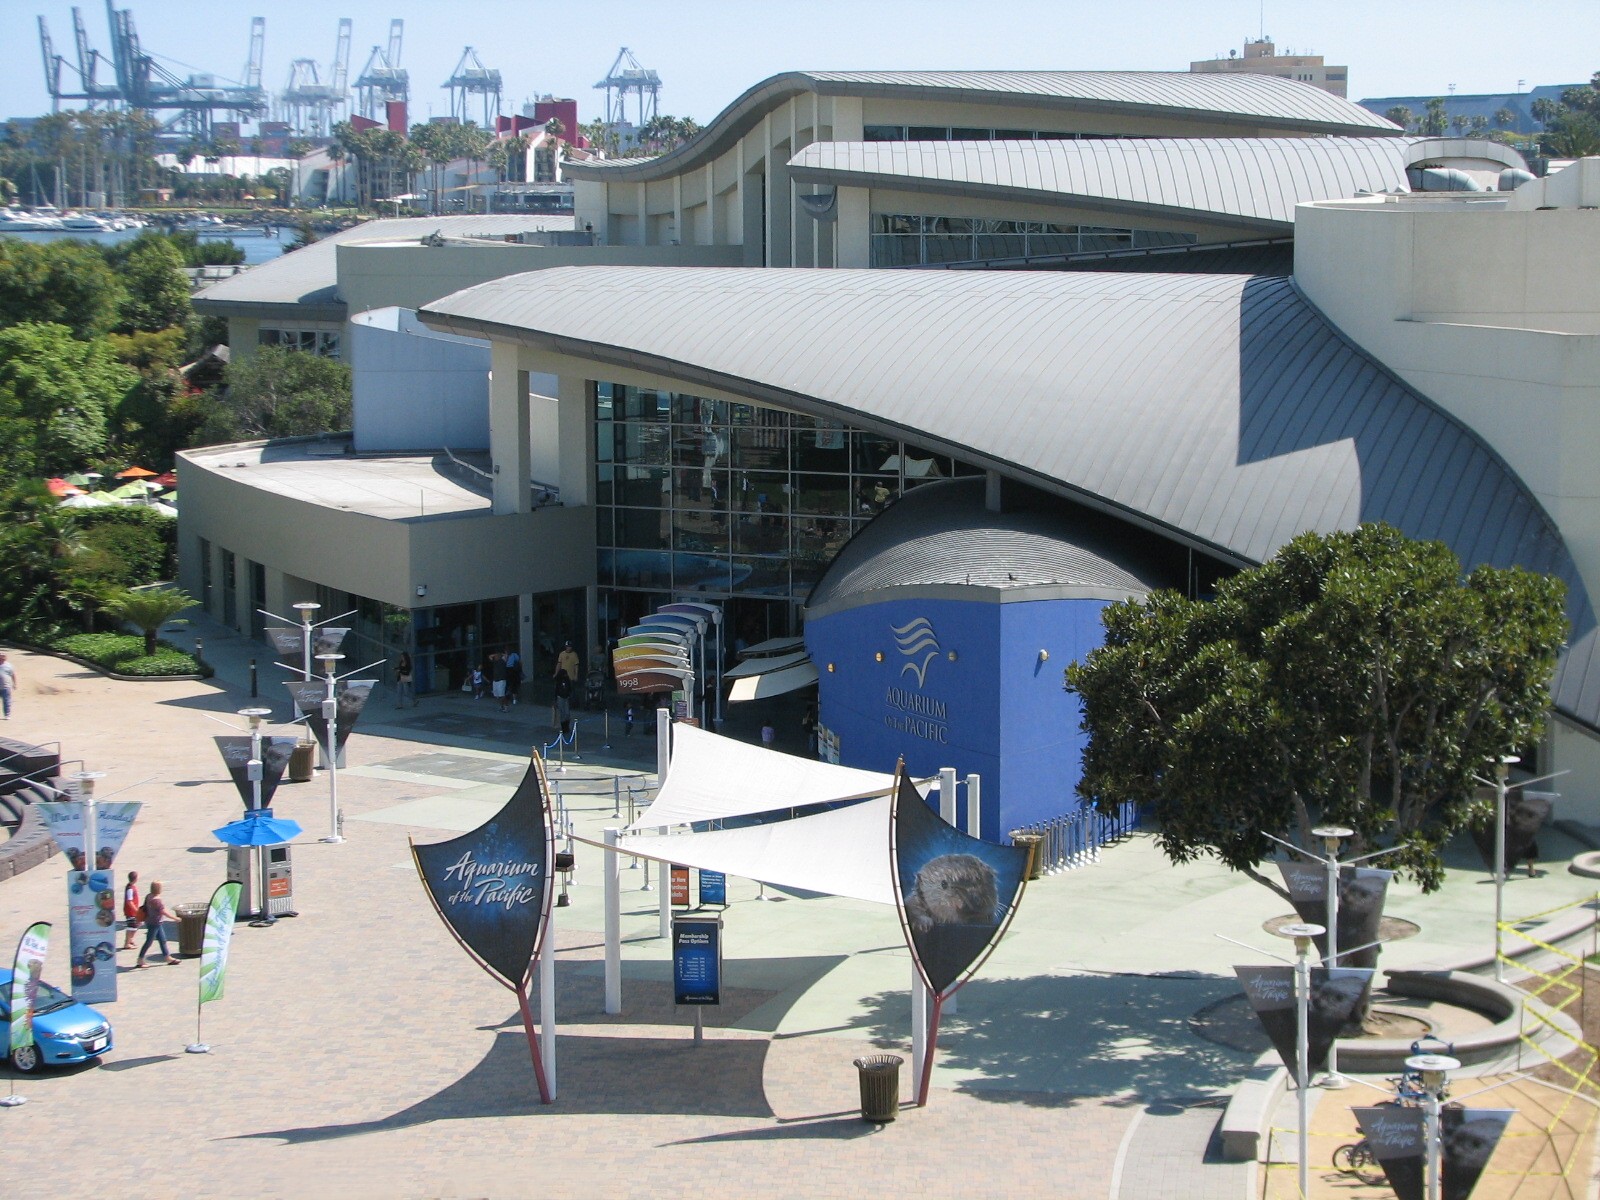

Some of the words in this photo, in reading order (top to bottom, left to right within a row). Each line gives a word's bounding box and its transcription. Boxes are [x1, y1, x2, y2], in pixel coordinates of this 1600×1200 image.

[619, 677, 639, 688] 1998
[886, 685, 947, 719] AQUARIUM
[905, 716, 948, 744] PACIFIC
[443, 850, 539, 891] Aquarium
[448, 890, 461, 906] of
[460, 890, 474, 903] the
[474, 878, 536, 910] Pacific
